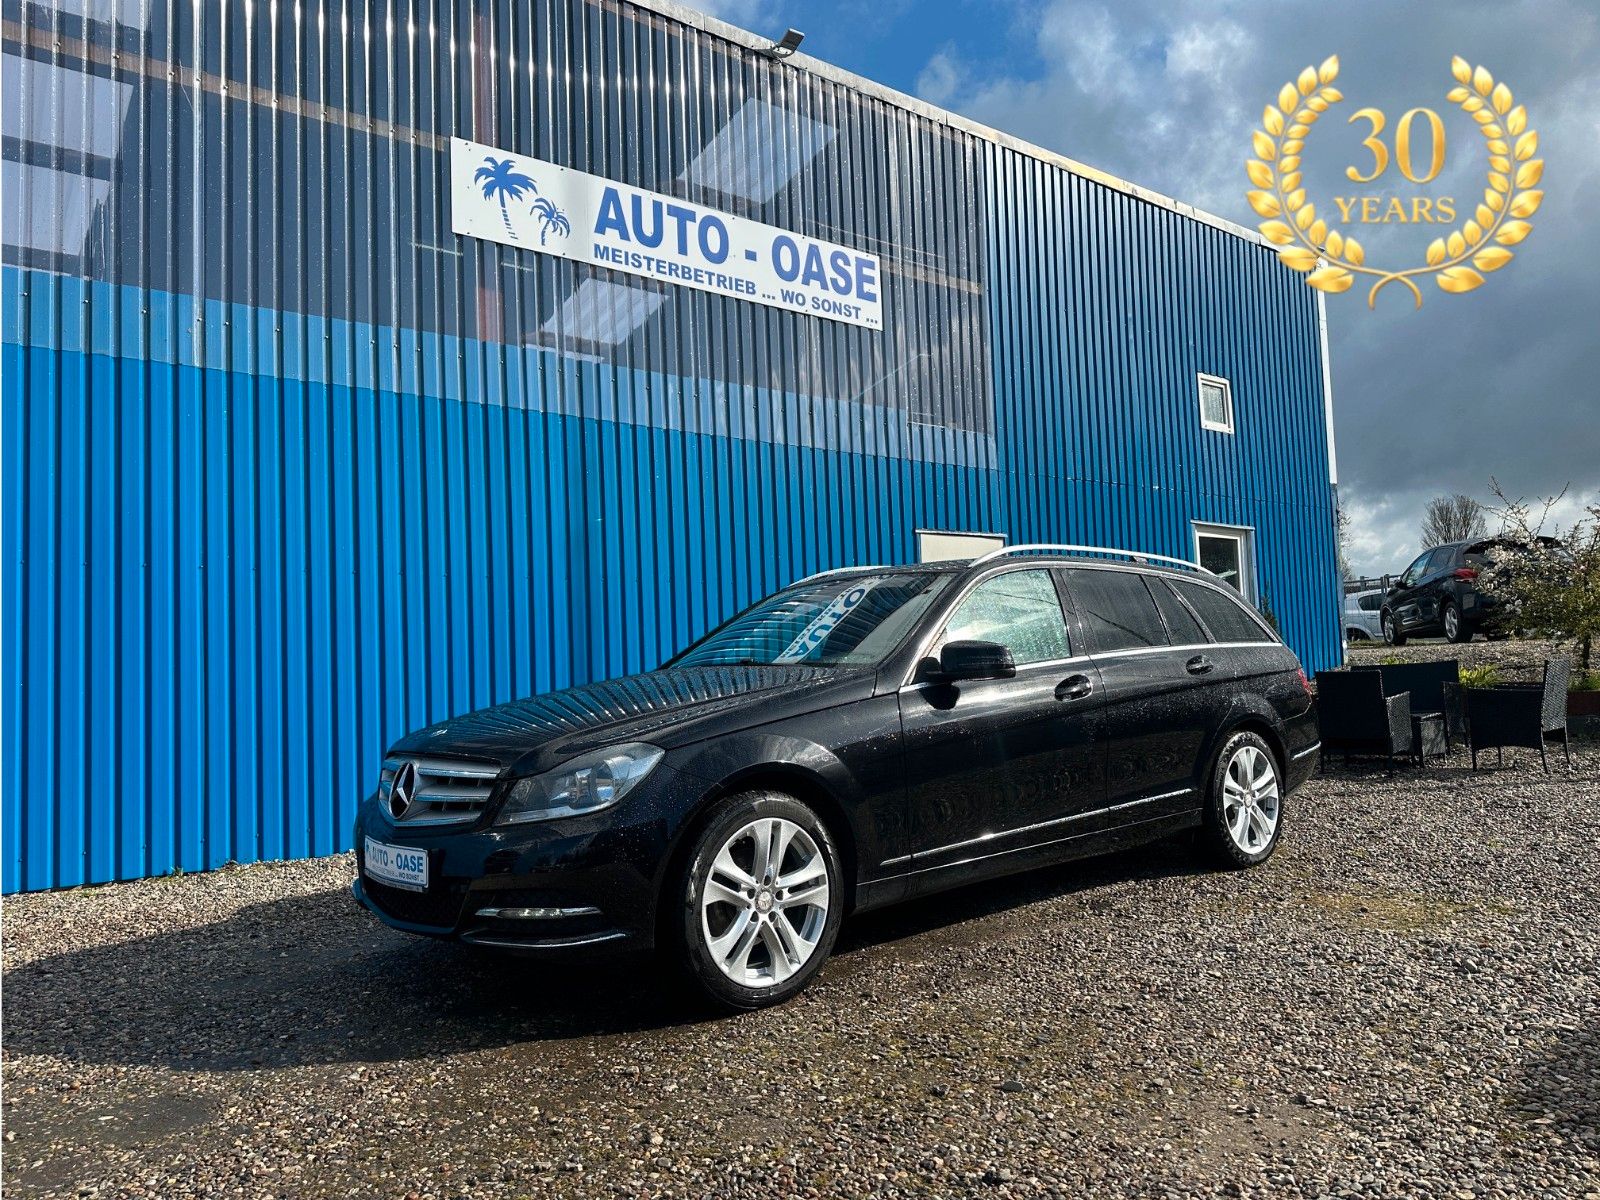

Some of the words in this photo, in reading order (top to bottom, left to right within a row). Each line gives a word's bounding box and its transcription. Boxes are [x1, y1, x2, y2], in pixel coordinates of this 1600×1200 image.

[593, 243, 757, 296] MEISTERBETRIEB
[780, 288, 807, 307] WO
[811, 296, 862, 319] SONST
[594, 186, 730, 265] AUTO
[771, 234, 877, 303] OASE
[372, 846, 389, 867] AUTO
[396, 852, 424, 873] OASE
